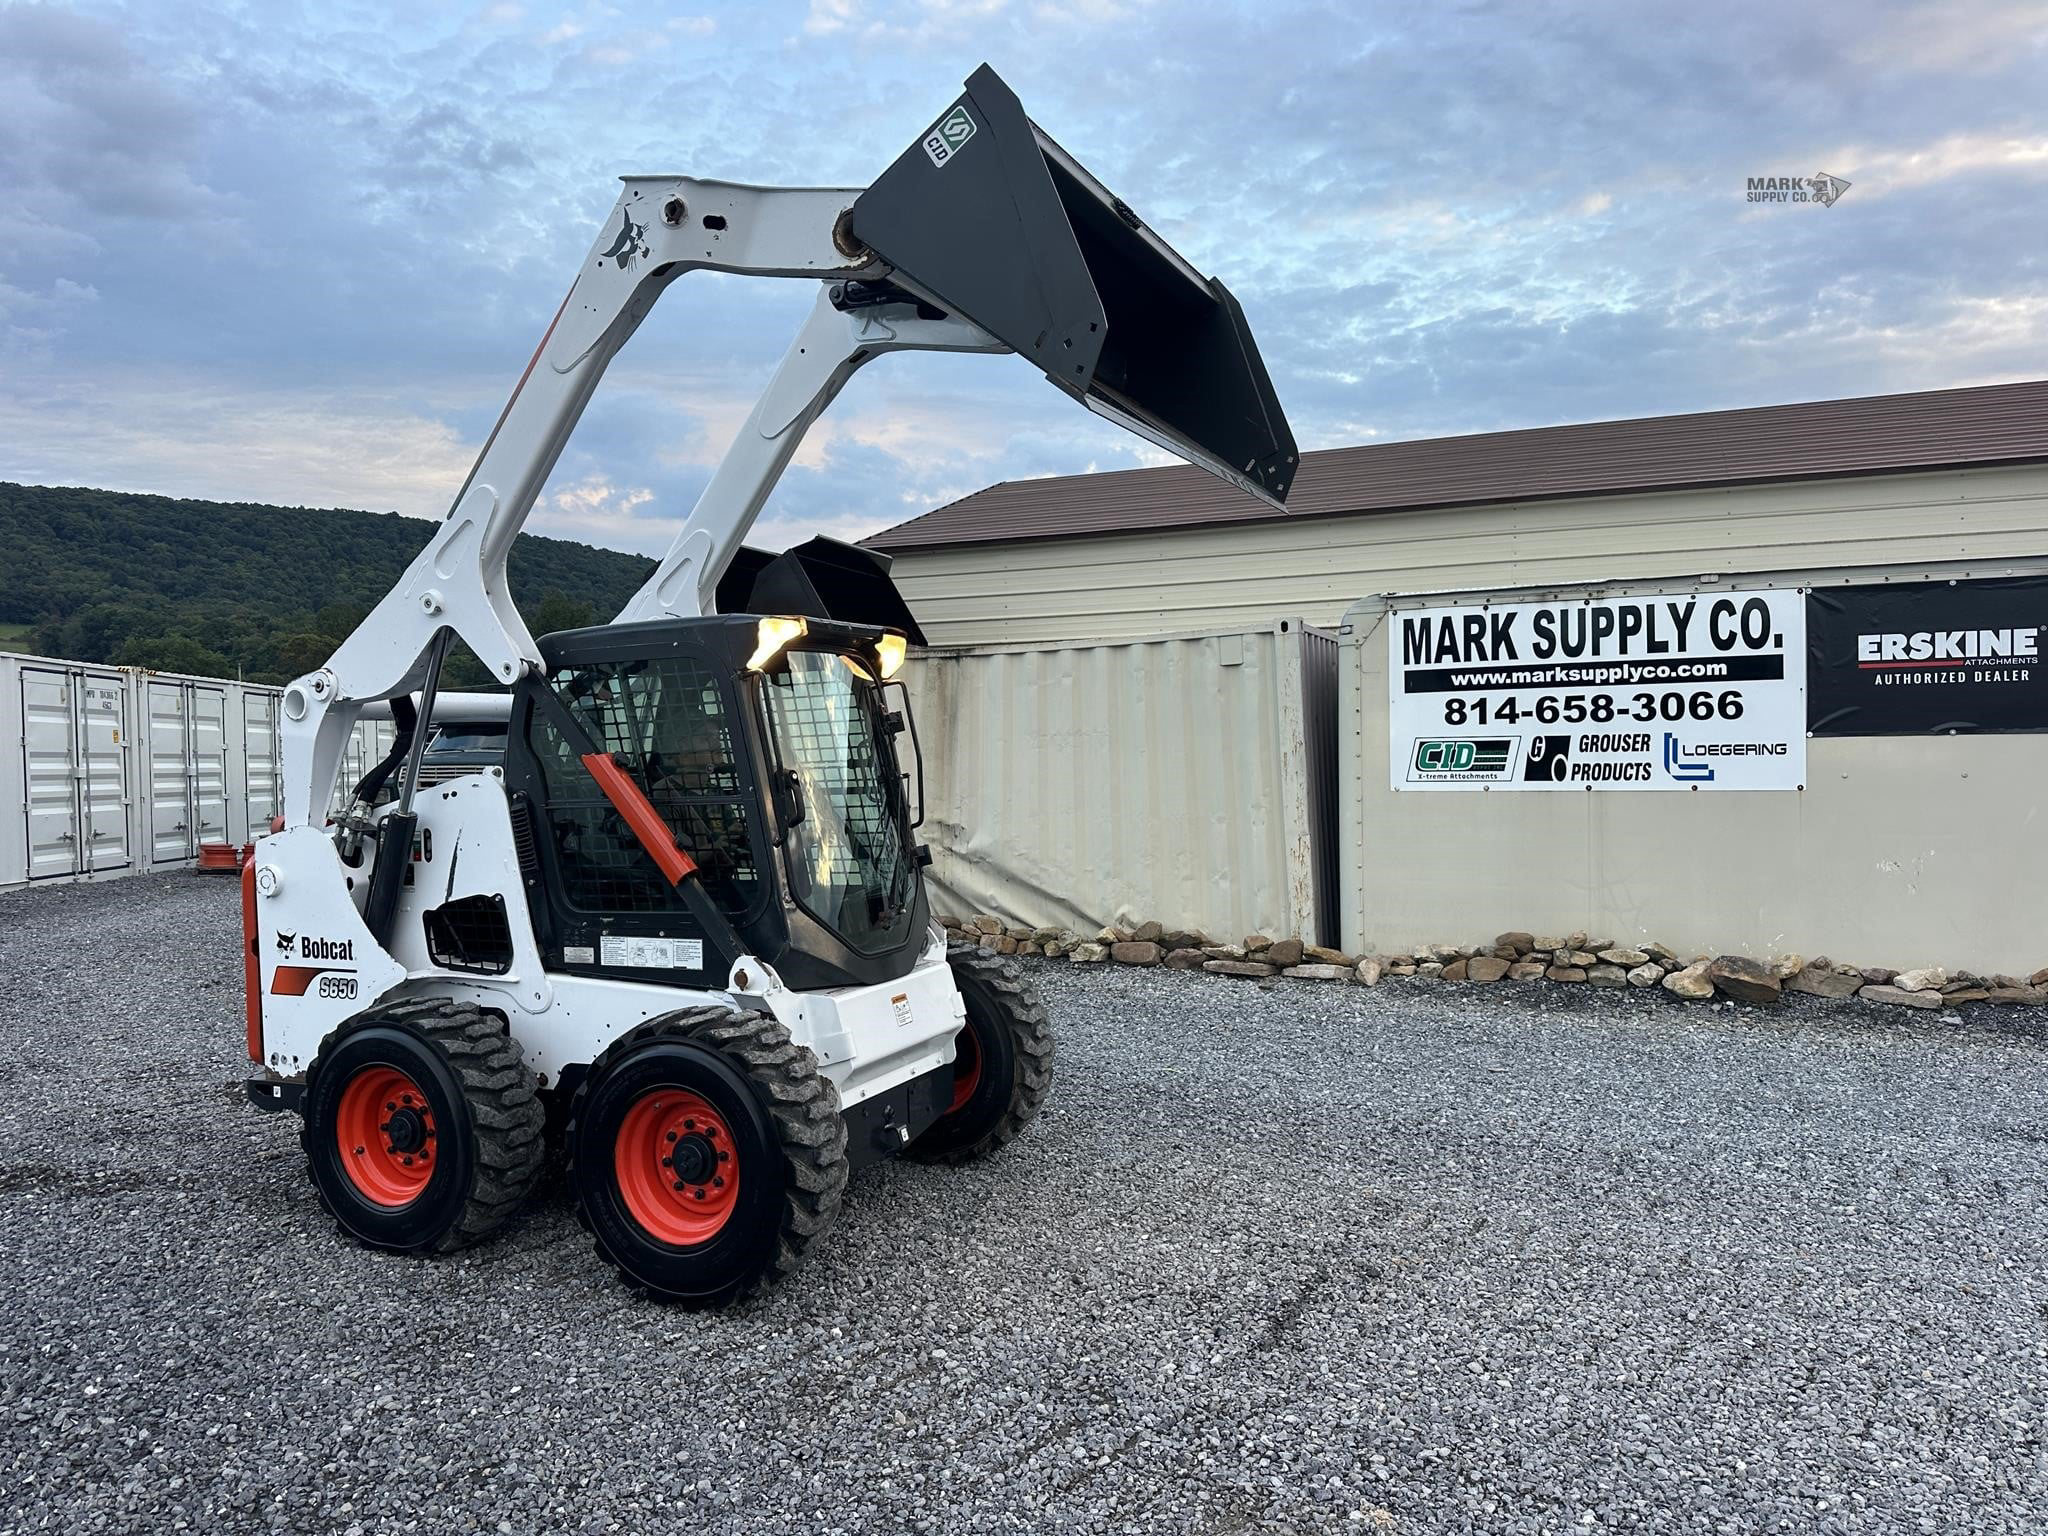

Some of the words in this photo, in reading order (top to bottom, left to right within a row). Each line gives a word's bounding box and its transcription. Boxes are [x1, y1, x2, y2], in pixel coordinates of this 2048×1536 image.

[927, 137, 948, 160] CID
[1402, 611, 1520, 665] MARK
[1532, 601, 1698, 659] SUPPLY
[1709, 597, 1784, 651] CO.
[1858, 627, 2038, 661] ERSKINE
[1451, 660, 1728, 686] www.marksupplyco.com
[1964, 657, 2039, 666] ATTACHMENTS
[1874, 671, 1966, 685] AUTHORIZED
[1975, 670, 2030, 682] DEALER
[1444, 690, 1745, 726] 814-658-3066
[1578, 733, 1652, 754] GROUSER
[1682, 743, 1788, 757] LOEGERING
[1418, 741, 1477, 771] CID
[1449, 772, 1498, 780] Attachments
[1570, 761, 1652, 782] PRODUCTS
[301, 936, 354, 961] Bobcat
[319, 976, 358, 1000] S650
